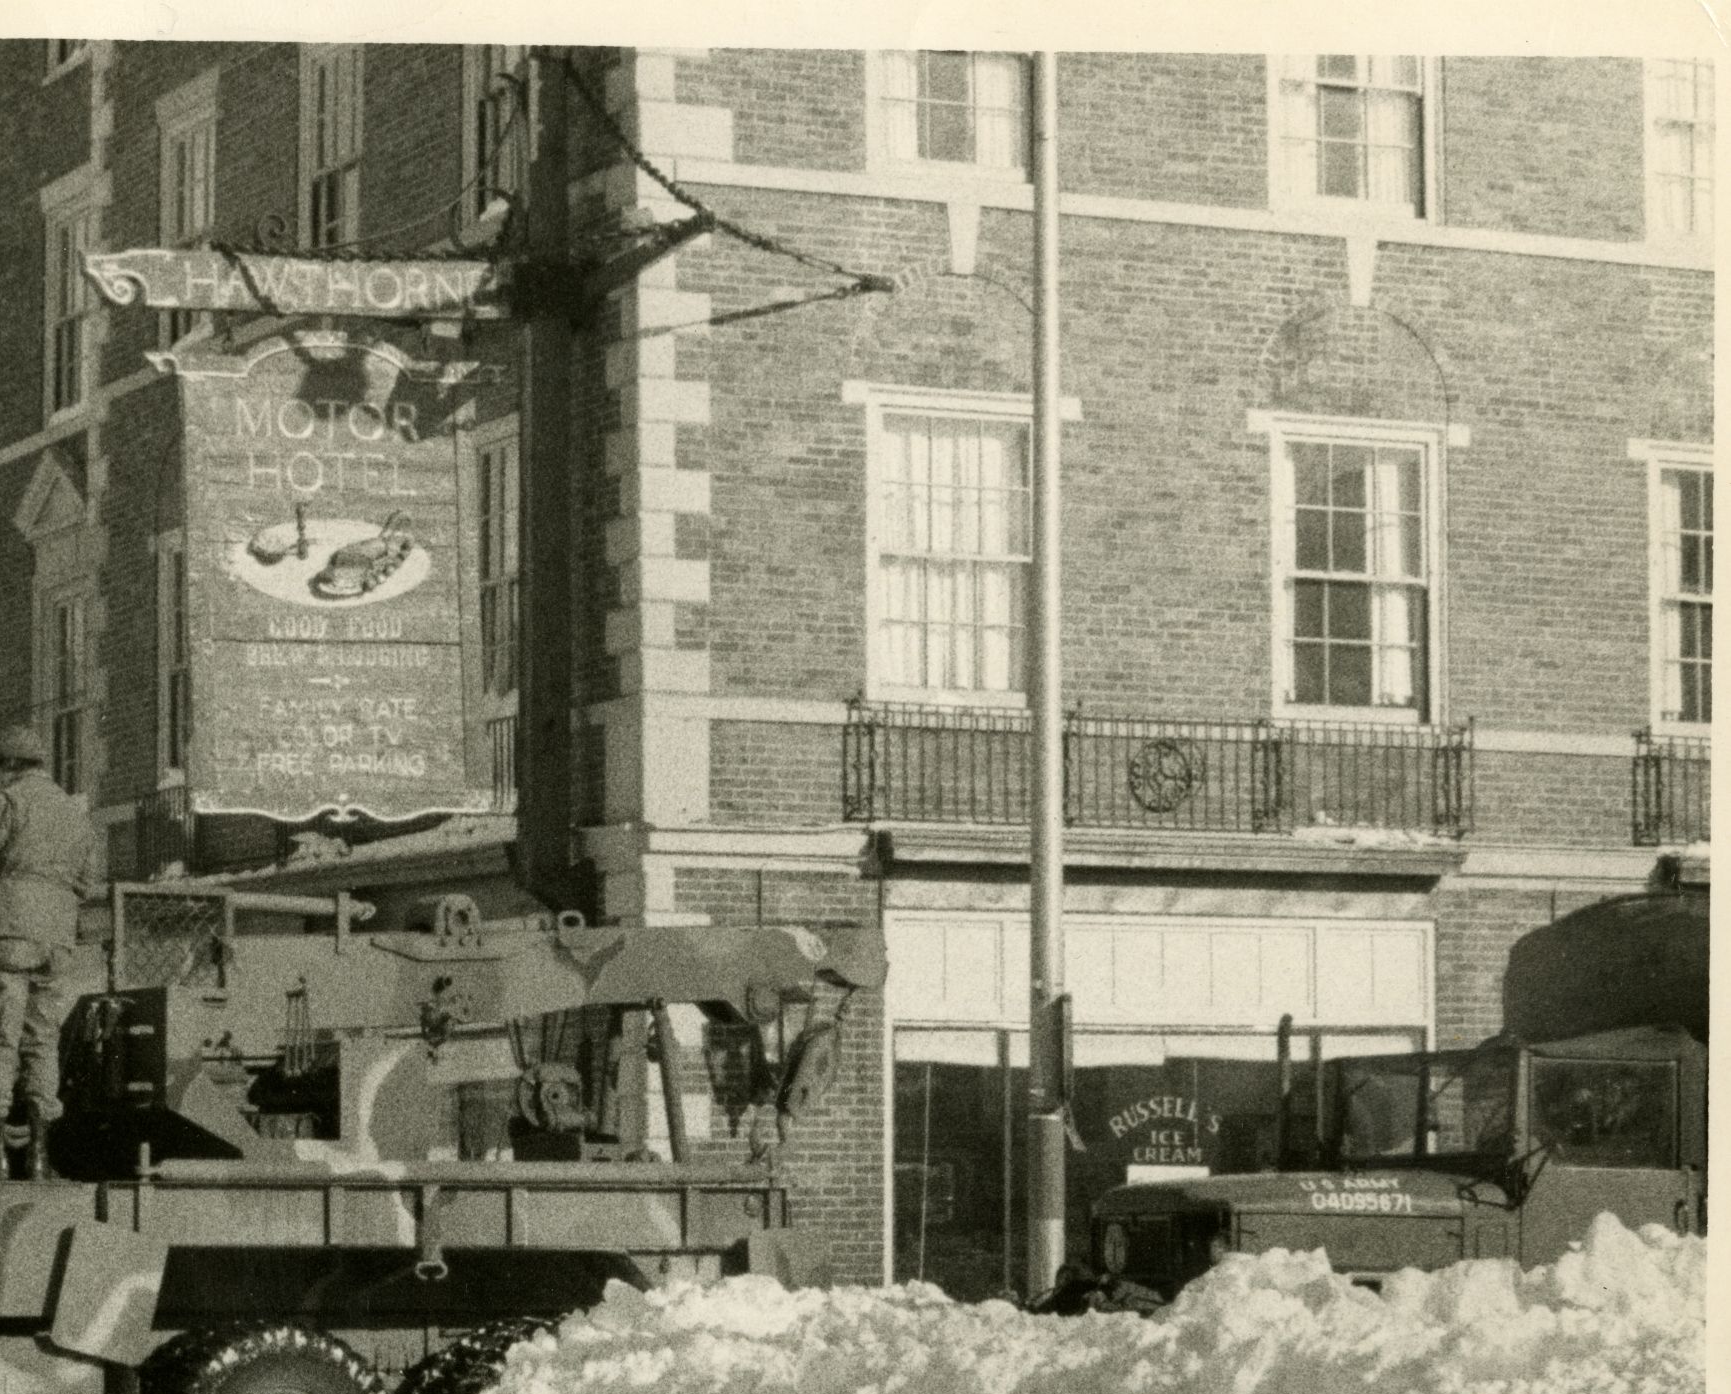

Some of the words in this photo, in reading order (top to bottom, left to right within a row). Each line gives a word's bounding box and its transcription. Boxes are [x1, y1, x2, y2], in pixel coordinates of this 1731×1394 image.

[235, 398, 419, 441] MOTOR
[248, 451, 417, 495] HOTEL
[345, 616, 402, 639] FOOD
[278, 724, 353, 747] COLOR
[368, 725, 402, 746] TV
[256, 753, 314, 776] FREE
[328, 753, 427, 777] PARKING
[1109, 1096, 1221, 1138] RUSSELL'S
[1150, 1130, 1185, 1145] ICE
[1133, 1148, 1202, 1162] CREAM
